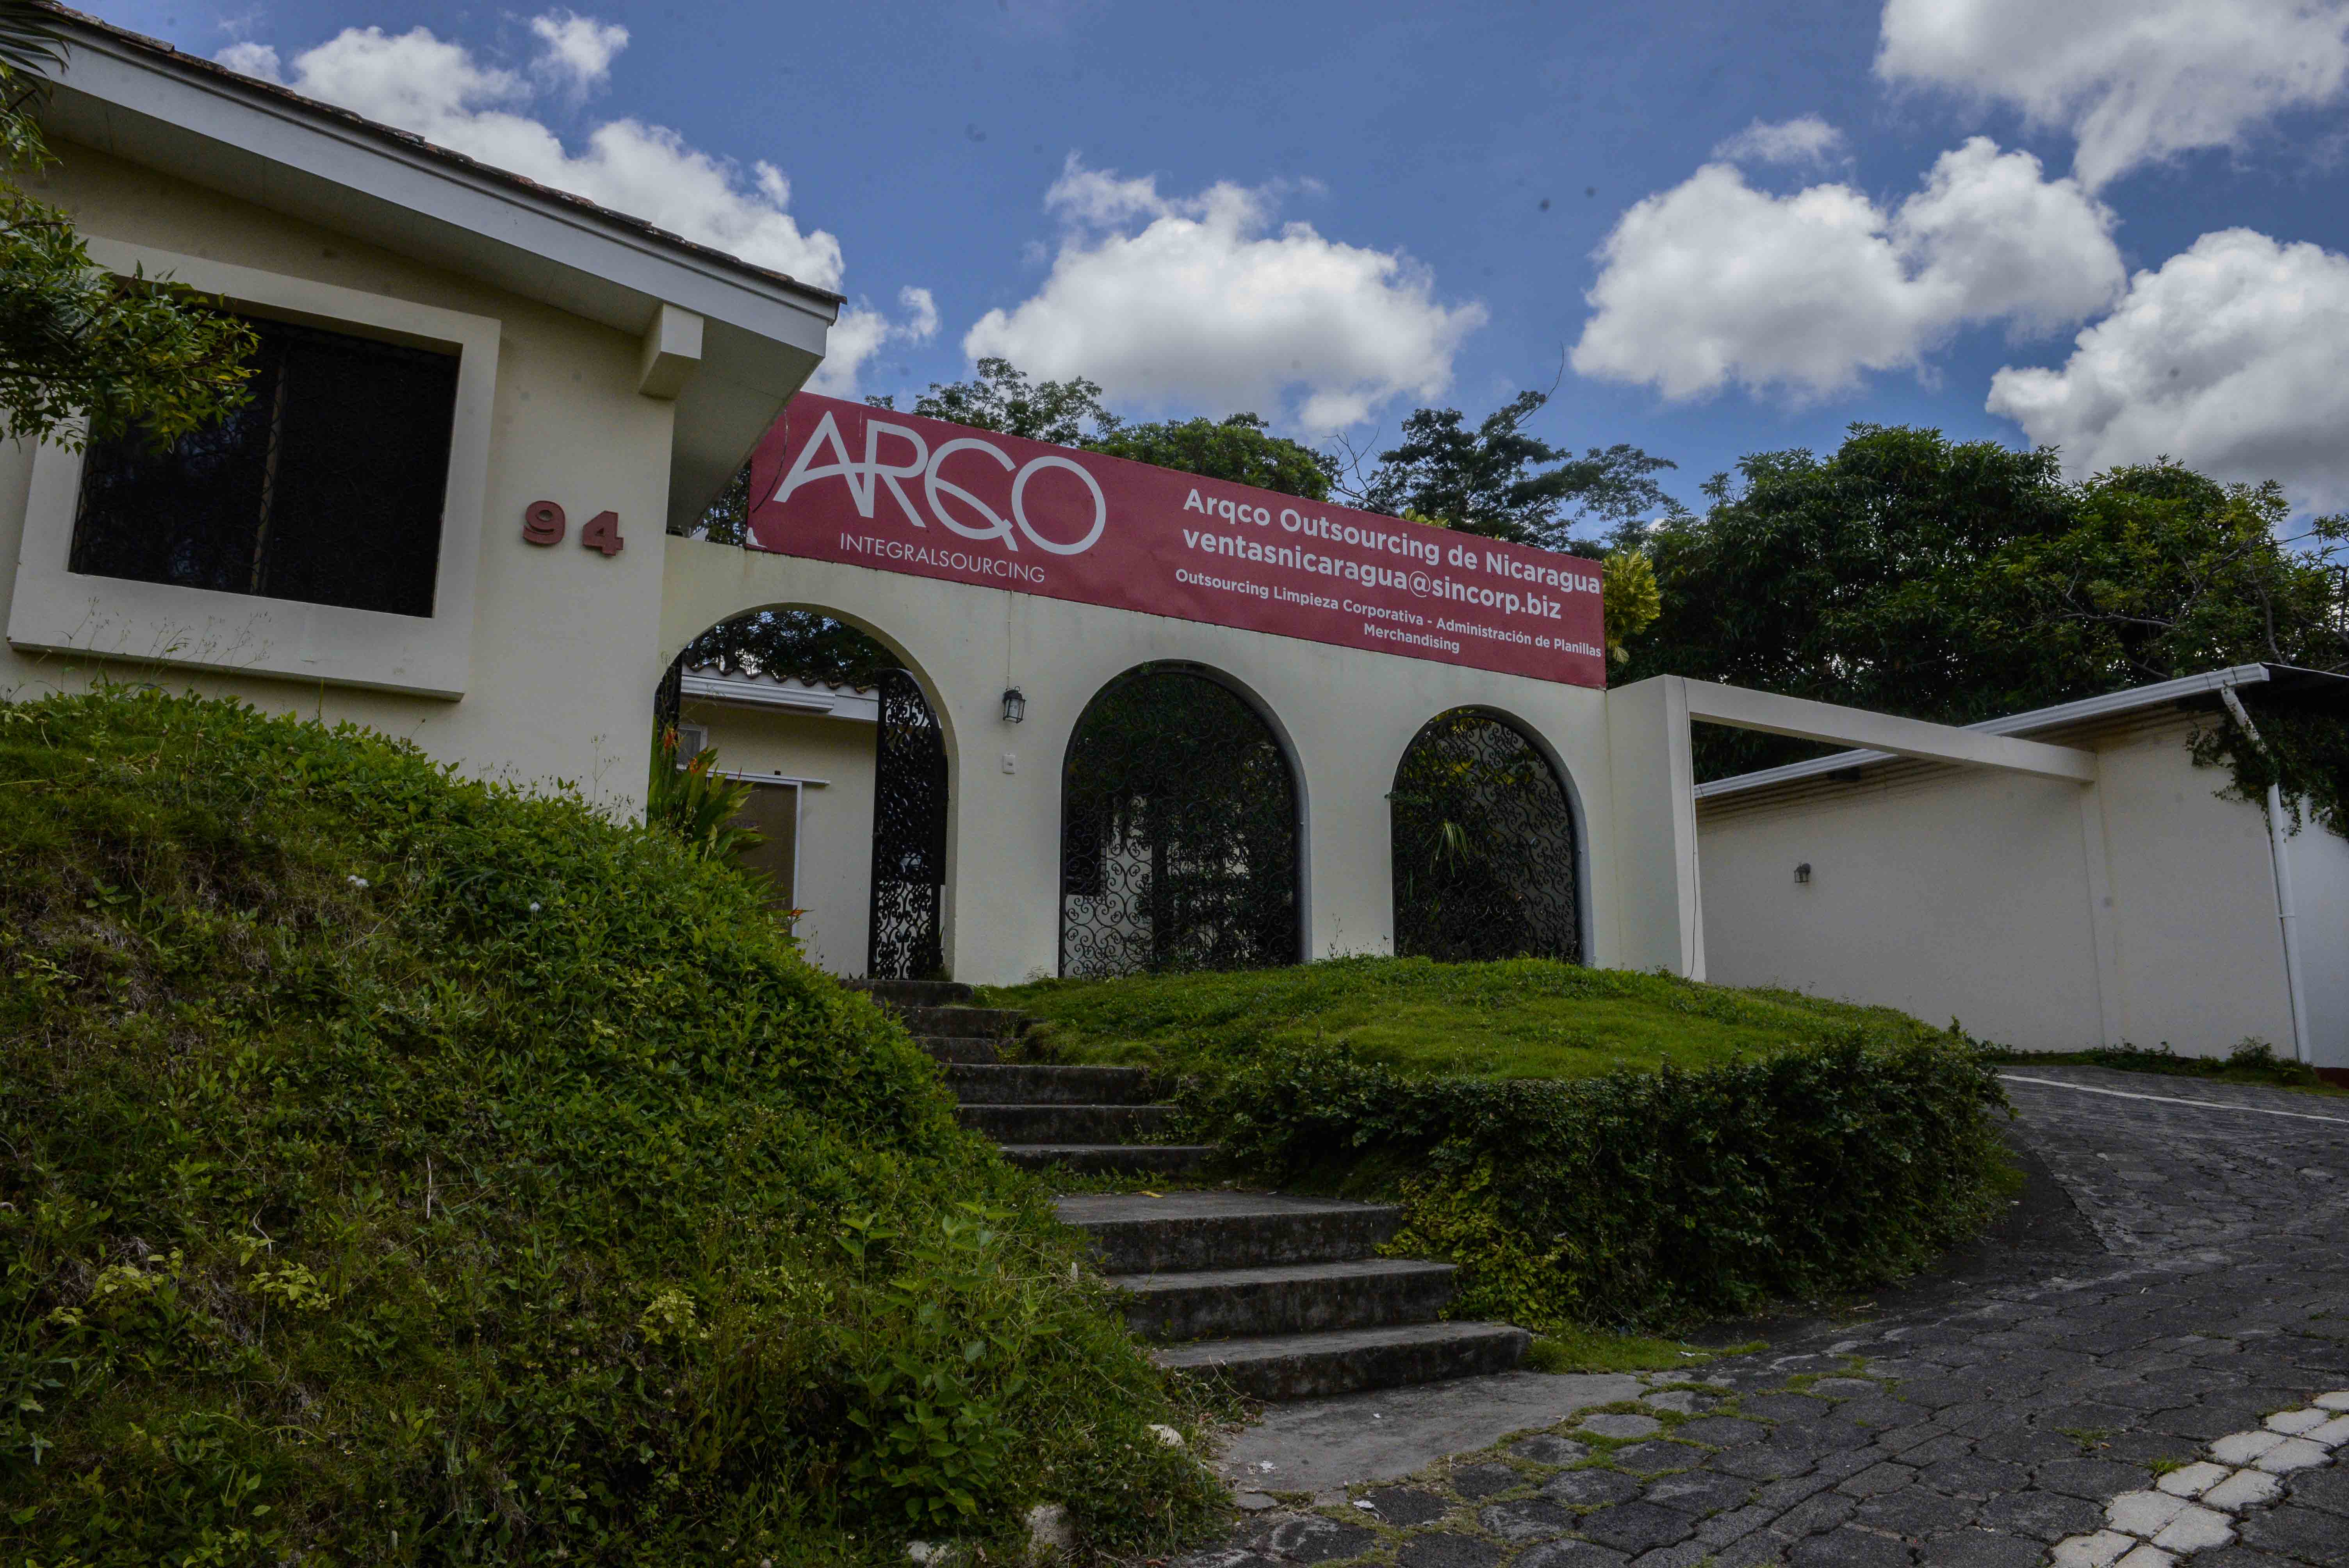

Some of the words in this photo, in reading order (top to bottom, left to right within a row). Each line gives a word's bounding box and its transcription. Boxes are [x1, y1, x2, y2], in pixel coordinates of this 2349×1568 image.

[522, 500, 624, 556] 94
[840, 533, 1046, 583] INTEGRALSOURCING
[1183, 488, 1270, 526] Arqco
[1280, 509, 1440, 565] Outsourcing
[1448, 545, 1477, 570] de
[1486, 552, 1600, 594] Nicaragua
[1183, 529, 1561, 619] ventasnicaragua@sincorp.biz
[1176, 568, 1269, 599] Outsourcing
[1273, 586, 1339, 610] Limpieza
[1343, 599, 1423, 626] Corporativa
[1436, 618, 1531, 645] Administración
[1535, 636, 1550, 647] de
[1554, 638, 1601, 657] Planillas
[1364, 623, 1460, 654] Merchandising
